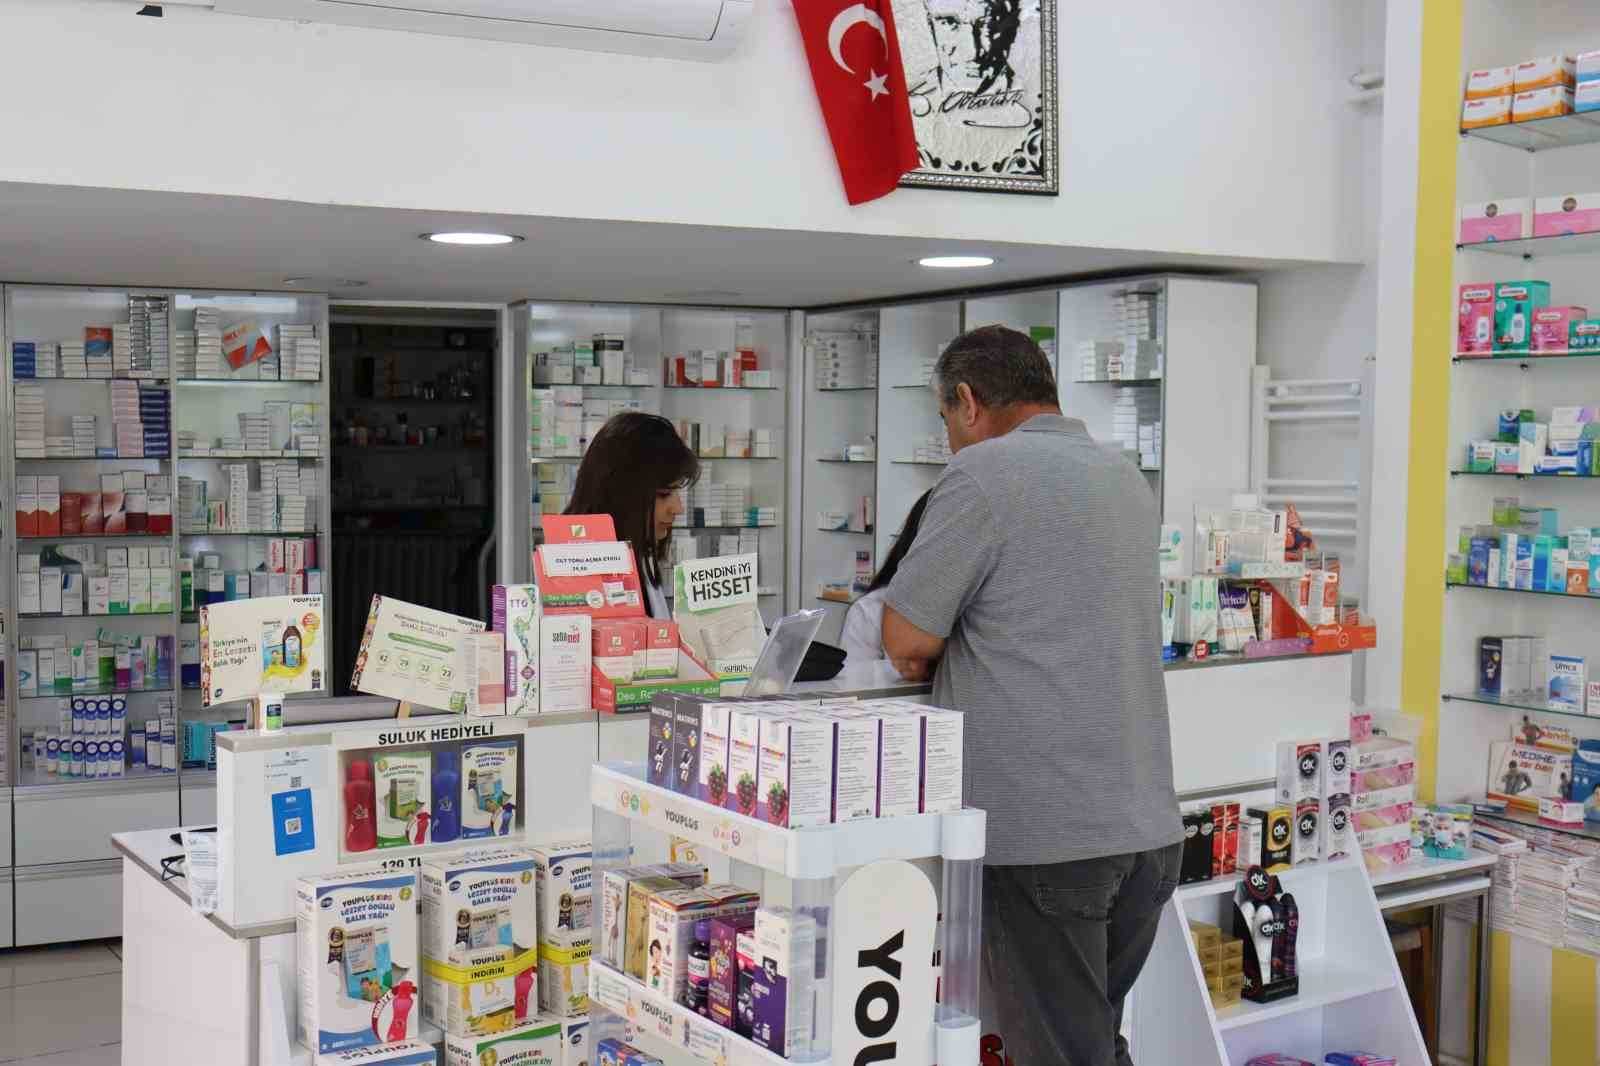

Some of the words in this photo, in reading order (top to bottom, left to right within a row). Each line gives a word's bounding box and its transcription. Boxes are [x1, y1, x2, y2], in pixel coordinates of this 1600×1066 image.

[378, 729, 428, 747] SULUK
[430, 724, 495, 742] HEDİYELİ
[664, 808, 699, 830] YOUPLUS
[471, 954, 505, 966] YOUPLUS
[640, 1000, 673, 1025] YOUPLUS
